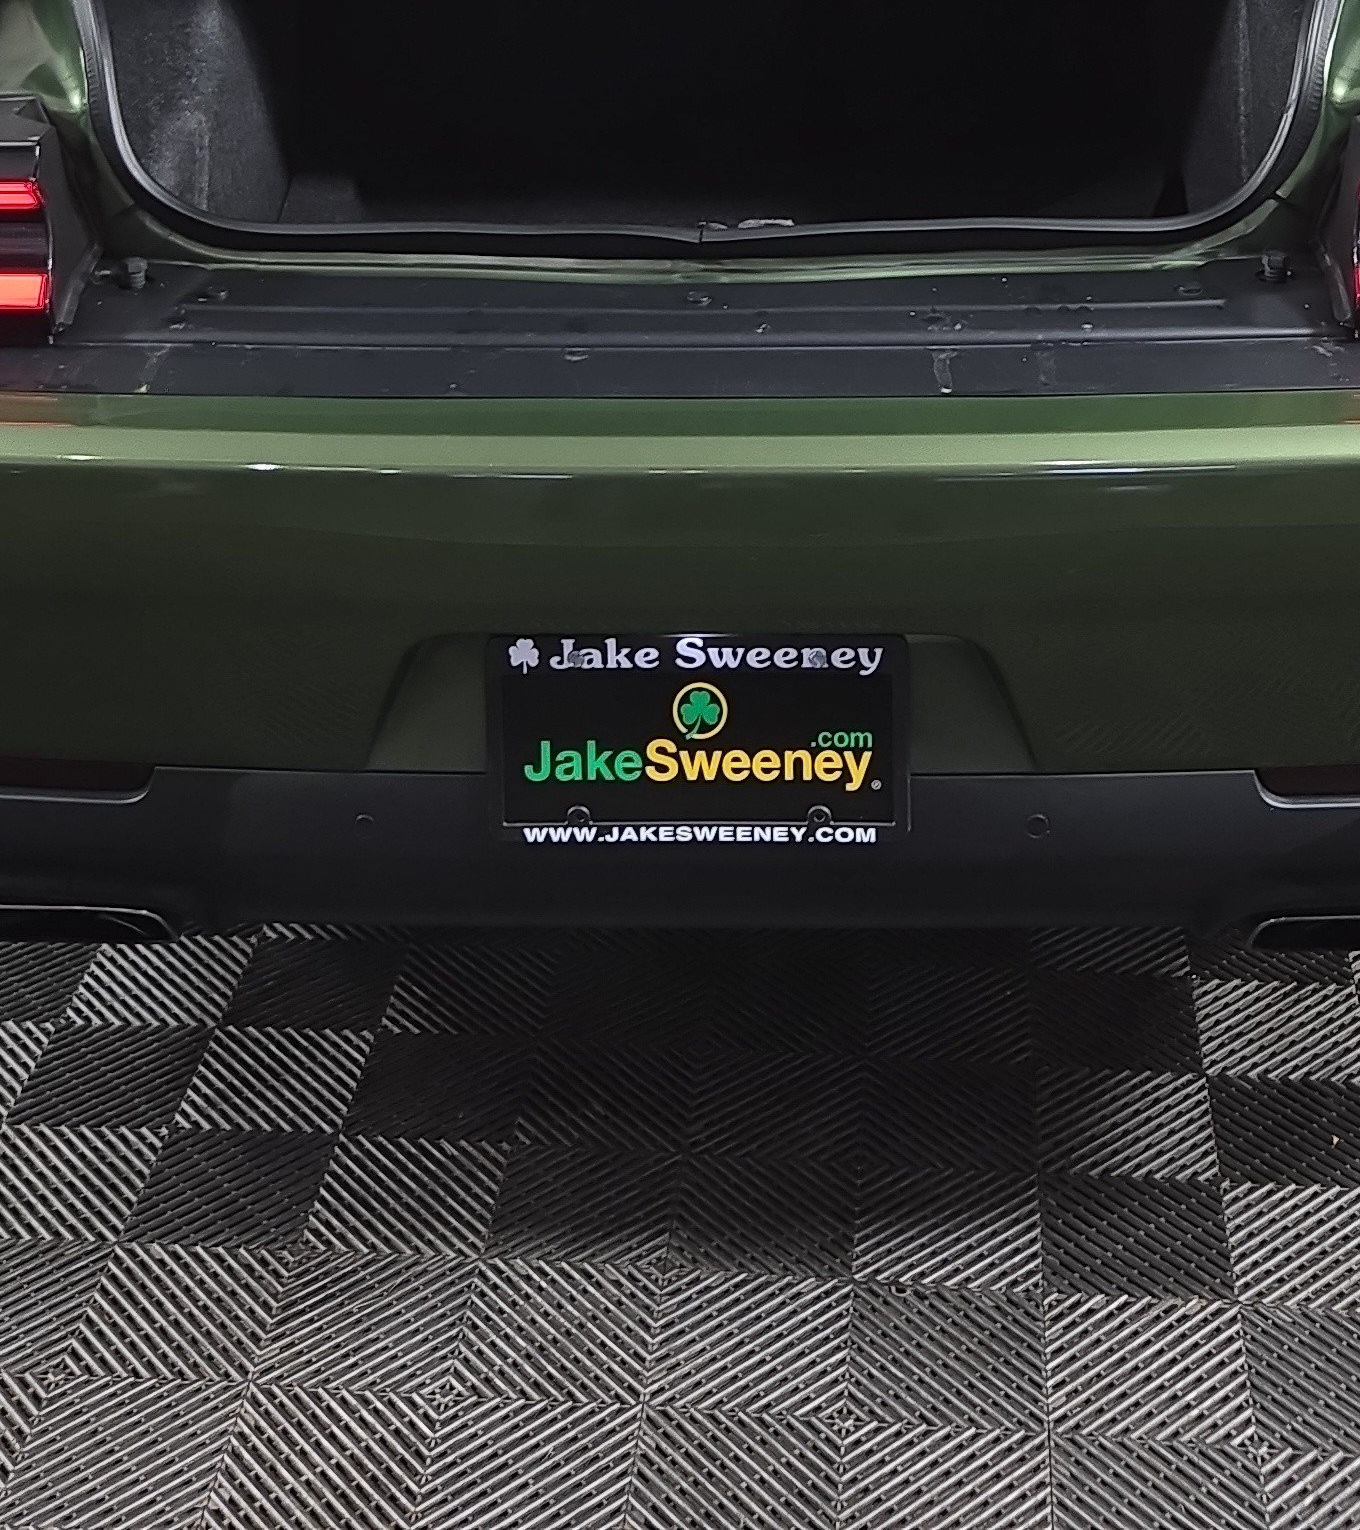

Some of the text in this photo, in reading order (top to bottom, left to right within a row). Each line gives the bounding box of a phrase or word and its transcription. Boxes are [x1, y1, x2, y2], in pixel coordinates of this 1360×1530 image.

[549, 637, 884, 676] Jake Sweeney
[810, 731, 874, 748] .com
[523, 825, 878, 844] WWW.JAKESWEENEY.COM
